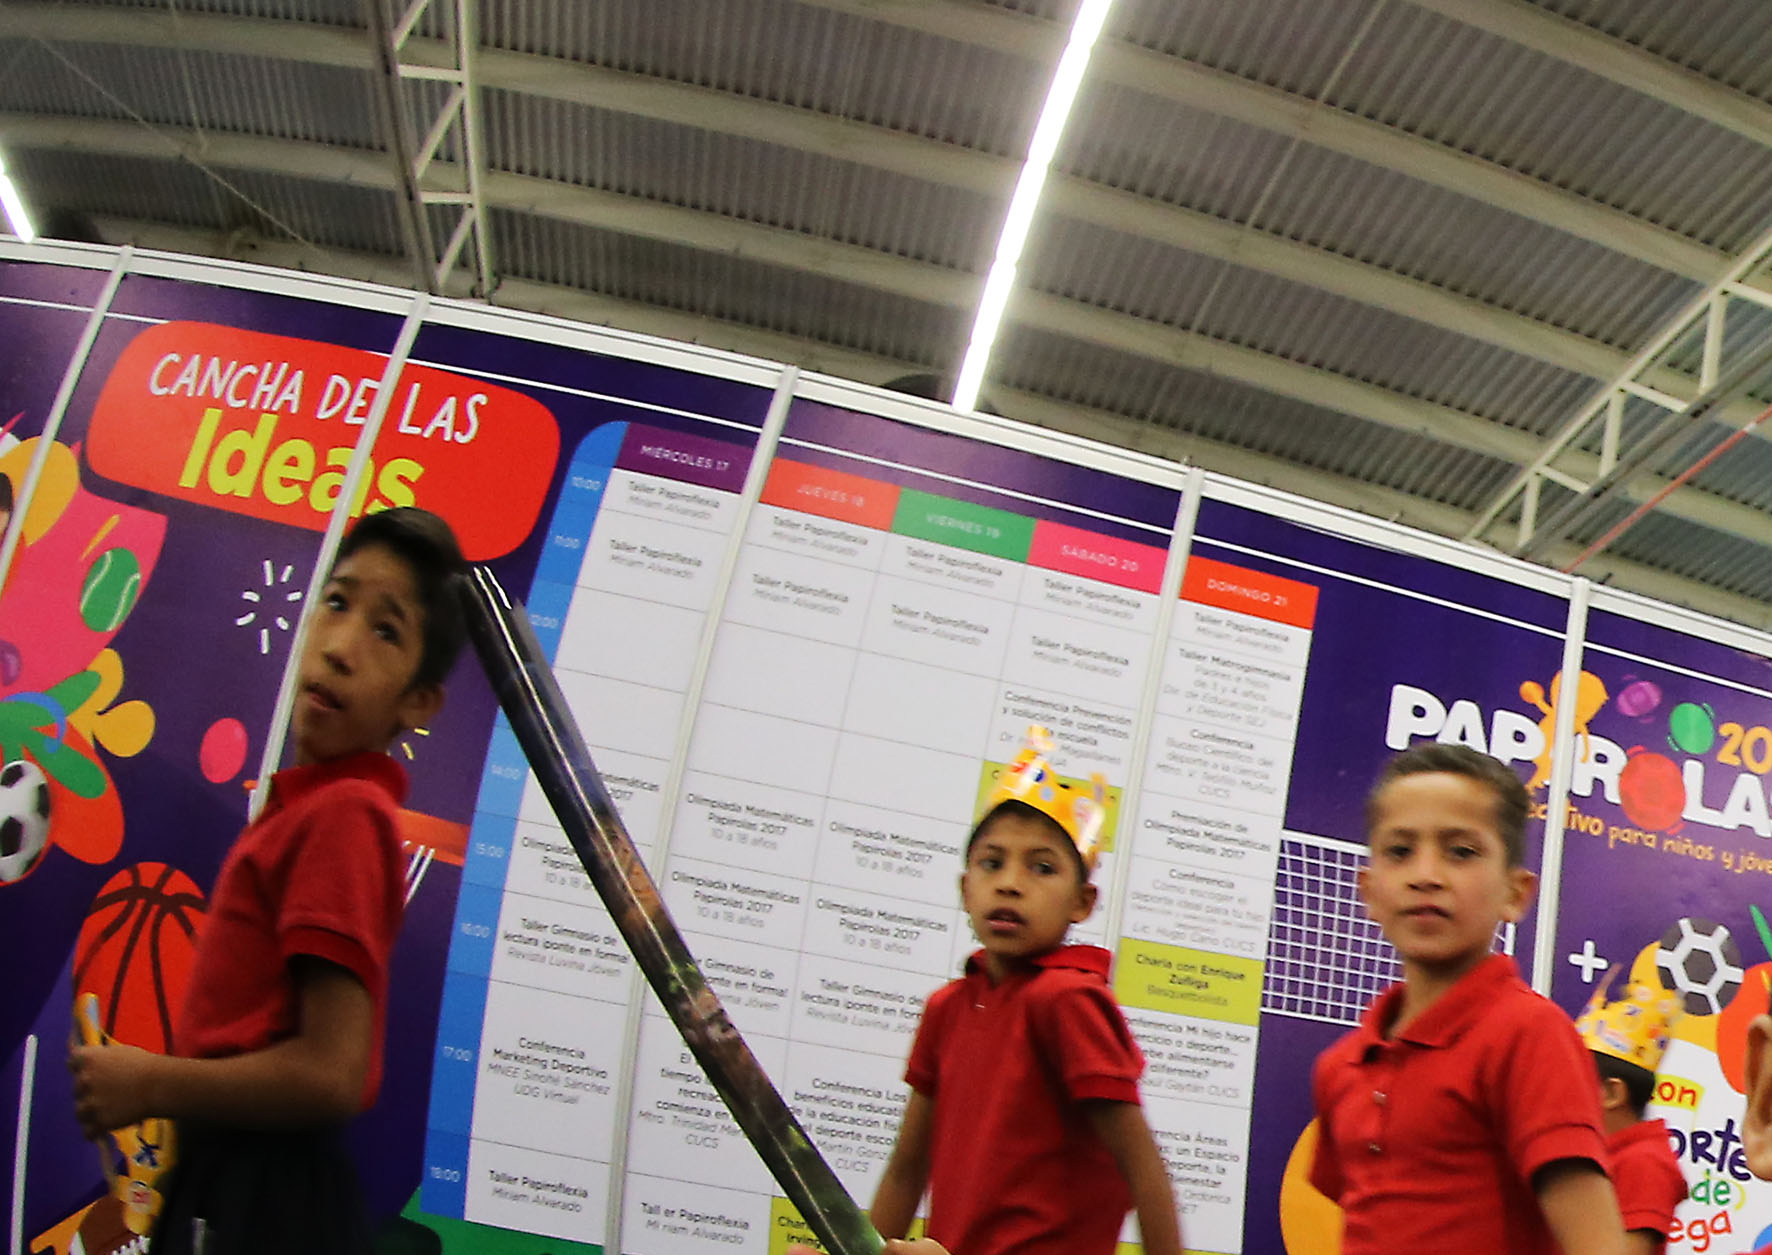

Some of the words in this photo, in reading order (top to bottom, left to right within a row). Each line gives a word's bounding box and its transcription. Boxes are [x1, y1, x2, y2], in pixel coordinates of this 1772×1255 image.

[149, 353, 302, 415] CANCHA
[317, 374, 380, 425] DE
[398, 383, 487, 445] LAS
[178, 408, 425, 519] Ideas
[572, 476, 601, 492] 10:00
[1207, 578, 1270, 603] DOMINGO
[688, 793, 742, 814] Olimpiada
[760, 822, 787, 836] 2017
[830, 820, 887, 841] Olimpiada
[1608, 826, 1657, 848] para
[1663, 836, 1715, 861] niños
[905, 851, 933, 864] 2017
[672, 870, 727, 891] Olimpiada
[746, 900, 773, 913] 2017
[816, 898, 874, 919] Olimpiada
[521, 918, 549, 933] Taller
[894, 928, 920, 941] 2017
[1136, 953, 1173, 969] Charla
[1200, 965, 1246, 981] Enrique
[820, 978, 849, 992] Taller
[519, 1037, 585, 1059] Conferencia
[494, 1048, 548, 1070] Marketing
[552, 1058, 608, 1080] Deportivo
[812, 1078, 881, 1100] Conferencia
[794, 1090, 854, 1111] beneficios
[1194, 1147, 1240, 1163] Espacio
[489, 1170, 519, 1185] Taller
[522, 1176, 588, 1199] Papiroflexia
[679, 1208, 749, 1230] Papiroflexia
[1667, 1209, 1731, 1252] ega
